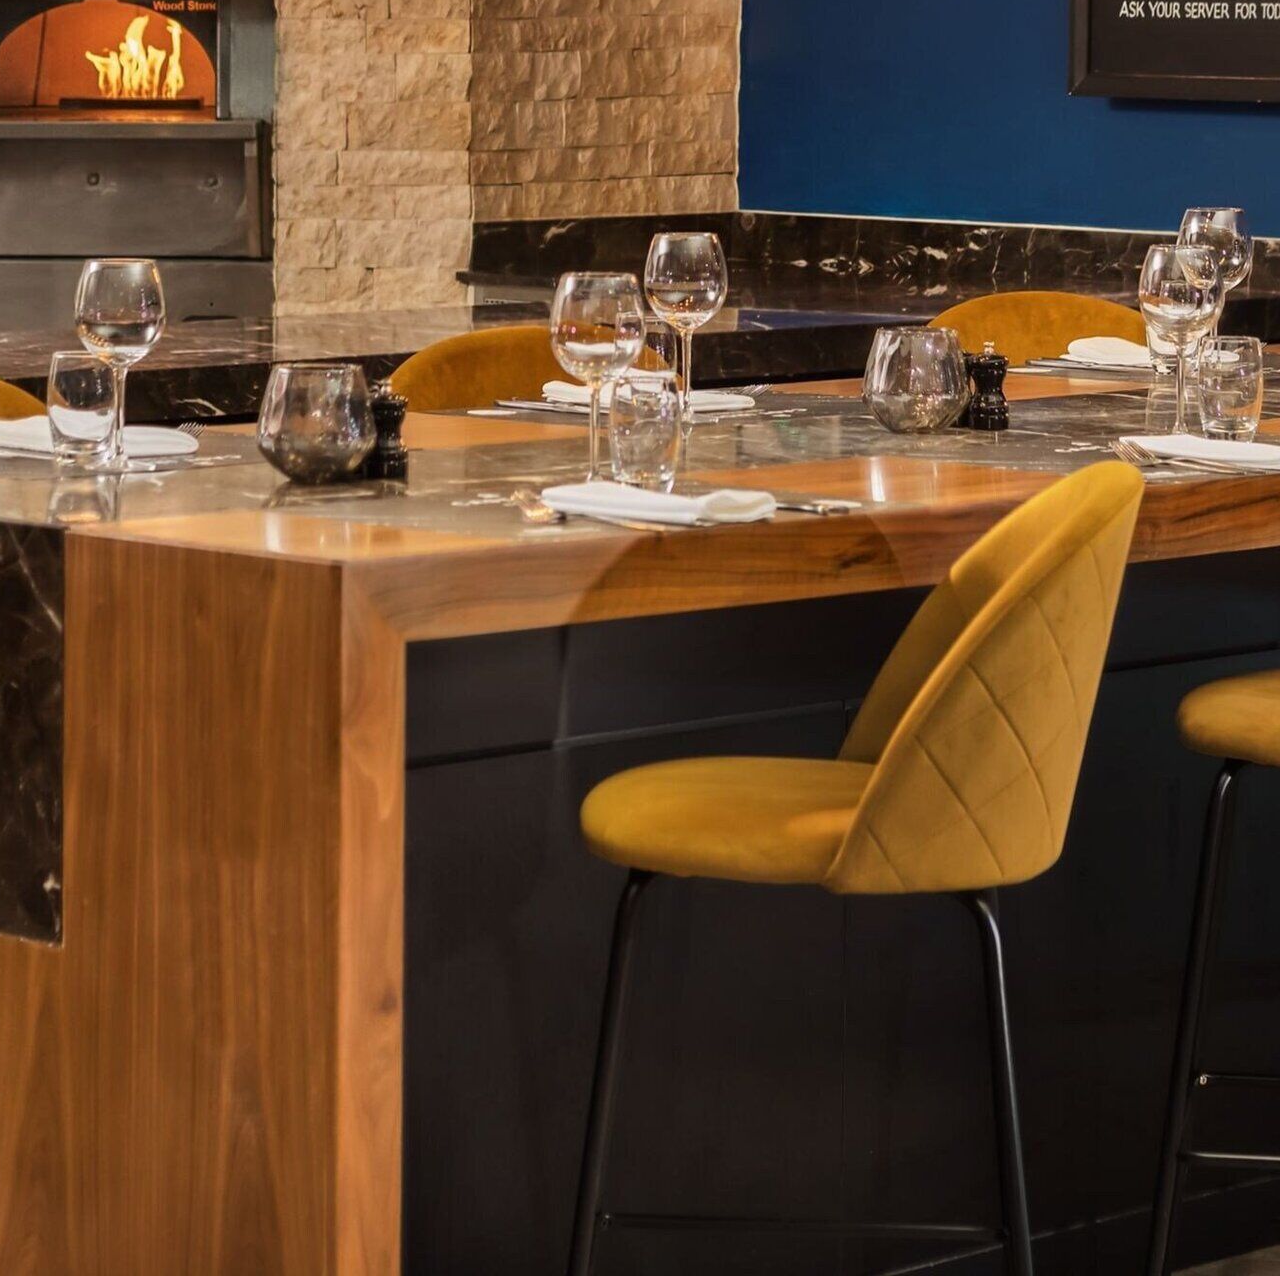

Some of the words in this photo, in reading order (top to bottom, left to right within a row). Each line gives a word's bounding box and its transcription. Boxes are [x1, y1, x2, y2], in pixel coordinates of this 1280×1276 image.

[152, 0, 184, 11] Wood
[1119, 0, 1145, 18] ASK
[1148, 0, 1181, 18] YOUR
[1184, 1, 1230, 19] SERVER
[1234, 2, 1257, 19] FOR
